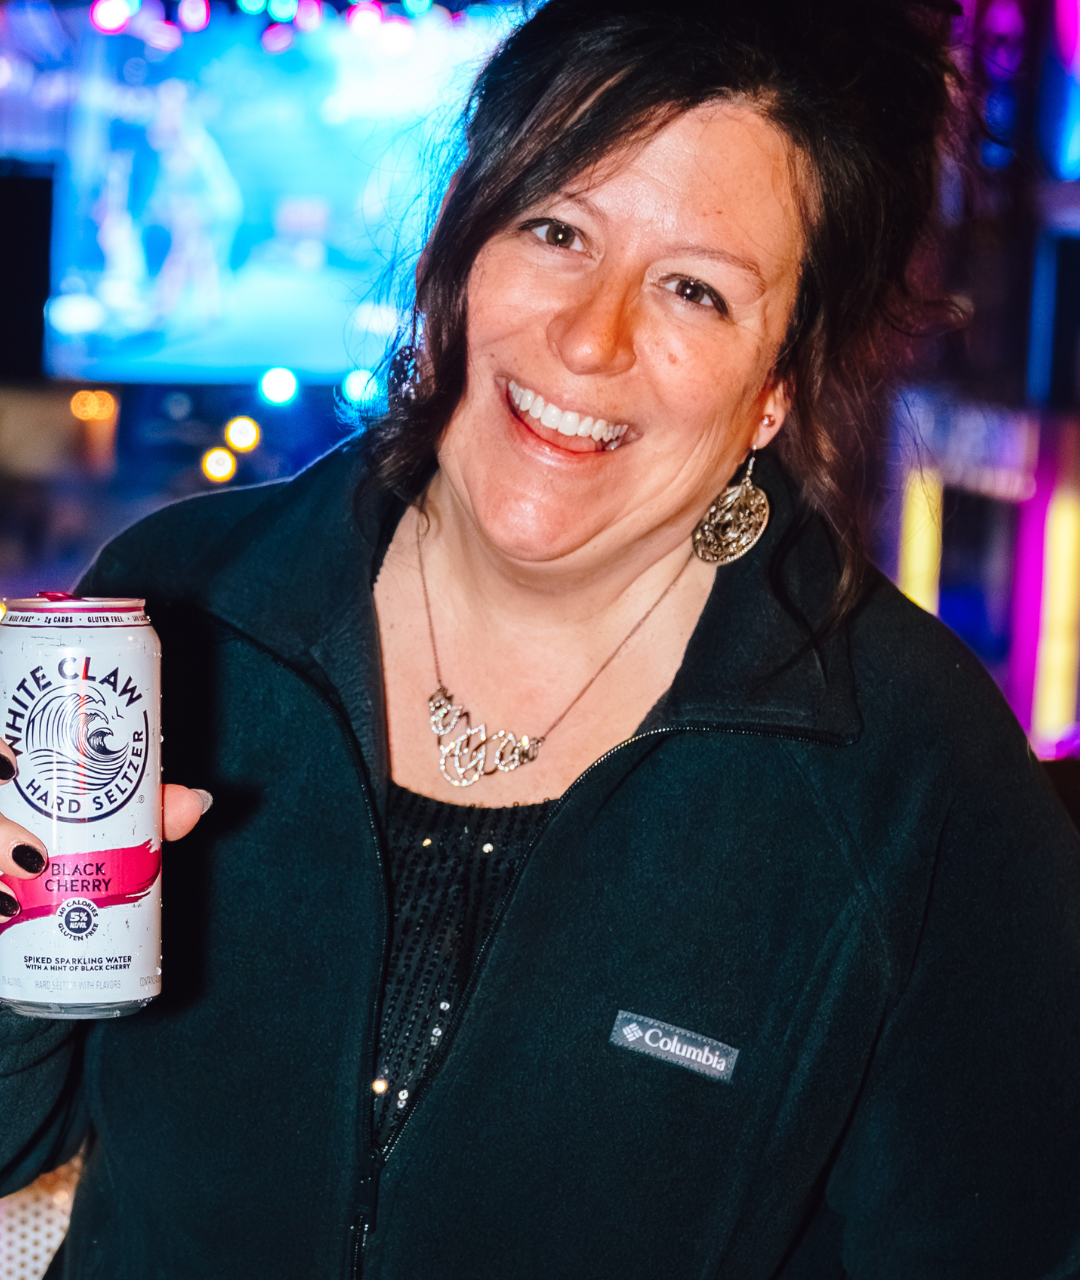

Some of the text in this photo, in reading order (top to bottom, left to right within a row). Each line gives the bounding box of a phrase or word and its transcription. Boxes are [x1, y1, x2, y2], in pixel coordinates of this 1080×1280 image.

[44, 616, 52, 624] 2g
[110, 615, 124, 623] FREE
[4, 656, 143, 757] WHITE CLAW
[25, 729, 144, 814] HARD SELTZER
[50, 862, 107, 877] BLACK
[44, 878, 113, 893] CHERRY
[58, 899, 99, 918] 140 CALORIES
[69, 911, 88, 922] 5%
[58, 922, 99, 941] GLUTEN FREE
[23, 955, 133, 965] SPIKED SPARKLING WATER
[25, 963, 42, 971] WITH
[80, 964, 104, 972] BLACK
[105, 963, 131, 971] CHERRY
[95, 979, 122, 990] FLAVORS
[644, 1027, 727, 1073] Columbia
